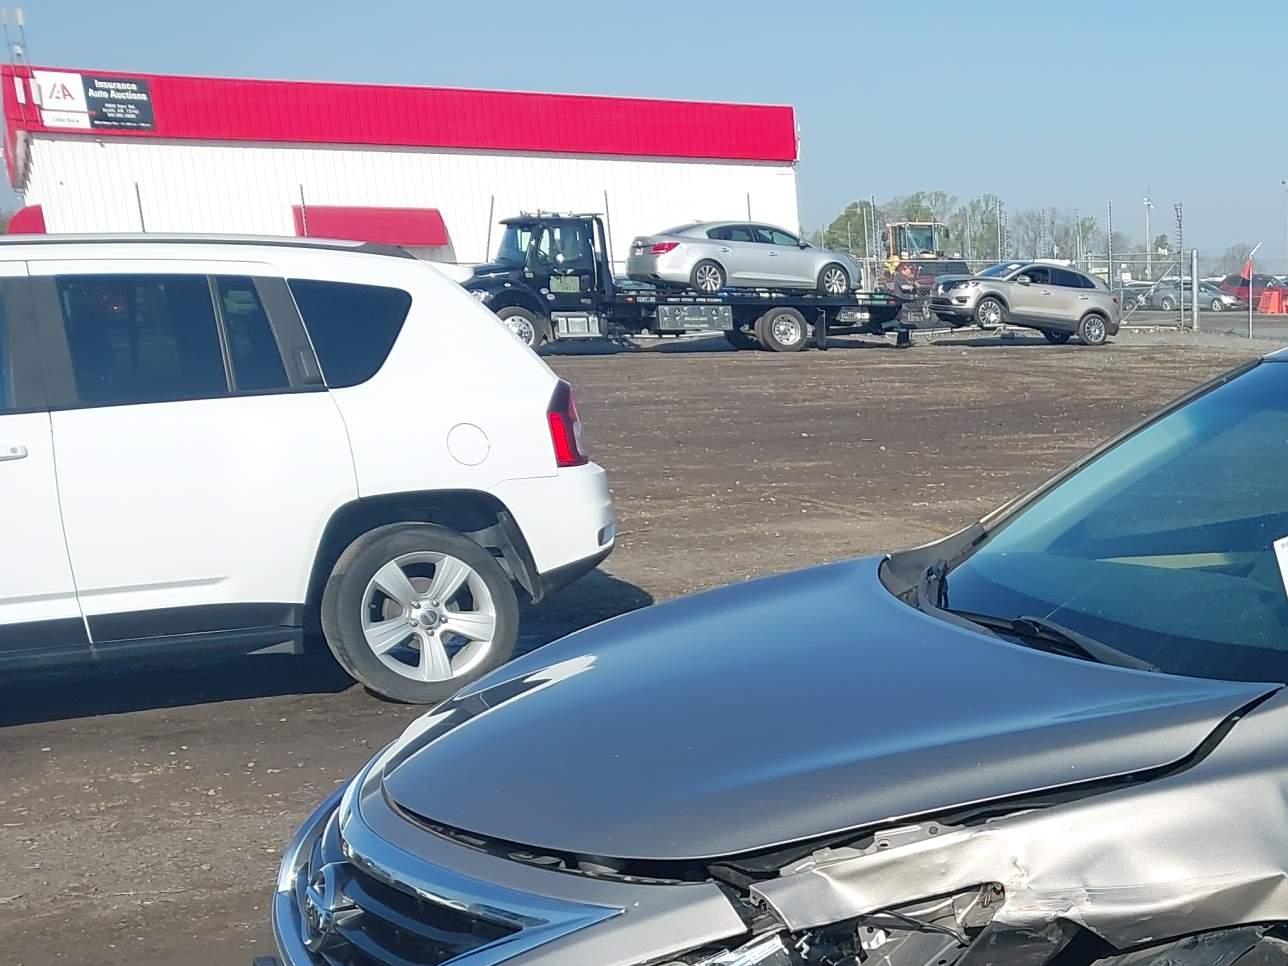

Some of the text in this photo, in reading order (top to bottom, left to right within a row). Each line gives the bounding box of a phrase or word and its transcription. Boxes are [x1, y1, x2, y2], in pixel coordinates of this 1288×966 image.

[94, 80, 137, 90] Insurance
[88, 88, 148, 100] Auto Auctions
